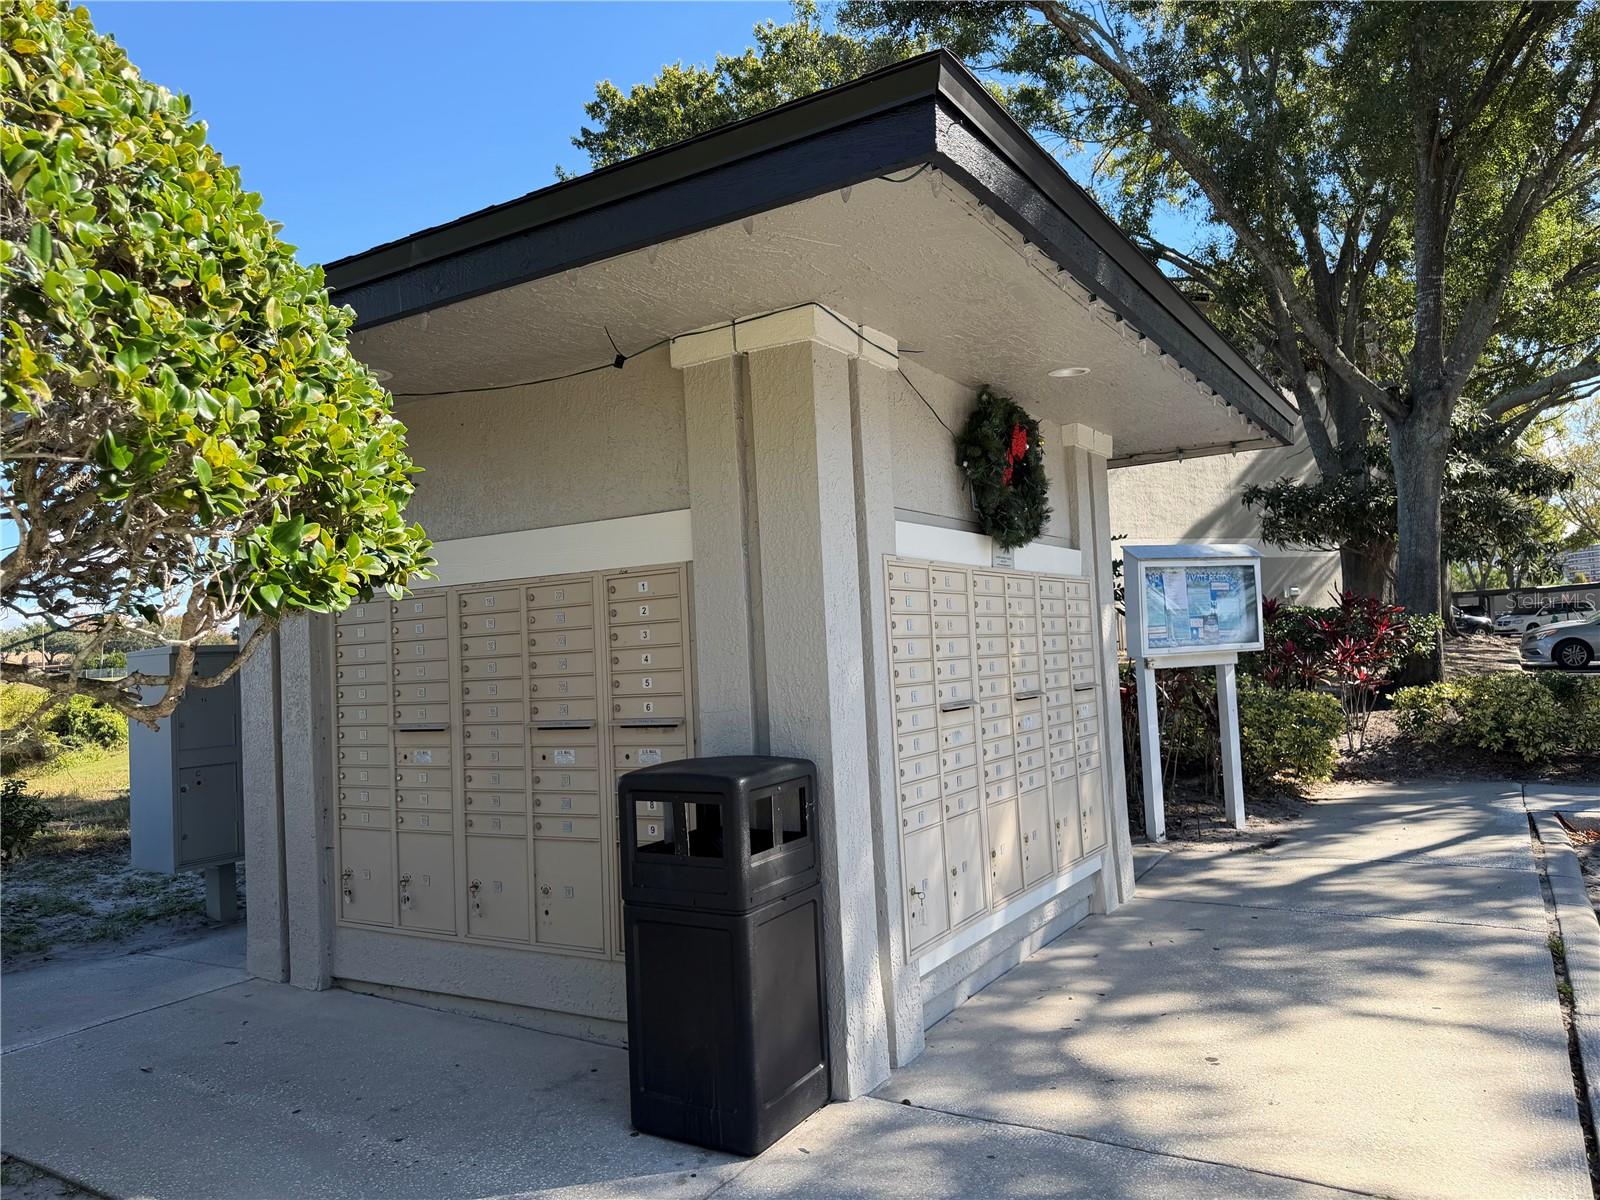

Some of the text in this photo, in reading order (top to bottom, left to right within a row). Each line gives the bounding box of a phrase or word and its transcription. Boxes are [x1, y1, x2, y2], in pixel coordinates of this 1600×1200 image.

[641, 606, 647, 615] 2
[642, 630, 648, 639] 3
[643, 655, 649, 663] 4
[645, 678, 650, 687] 5
[645, 703, 651, 711] 6
[649, 800, 655, 809] 8
[650, 825, 656, 834] 9
